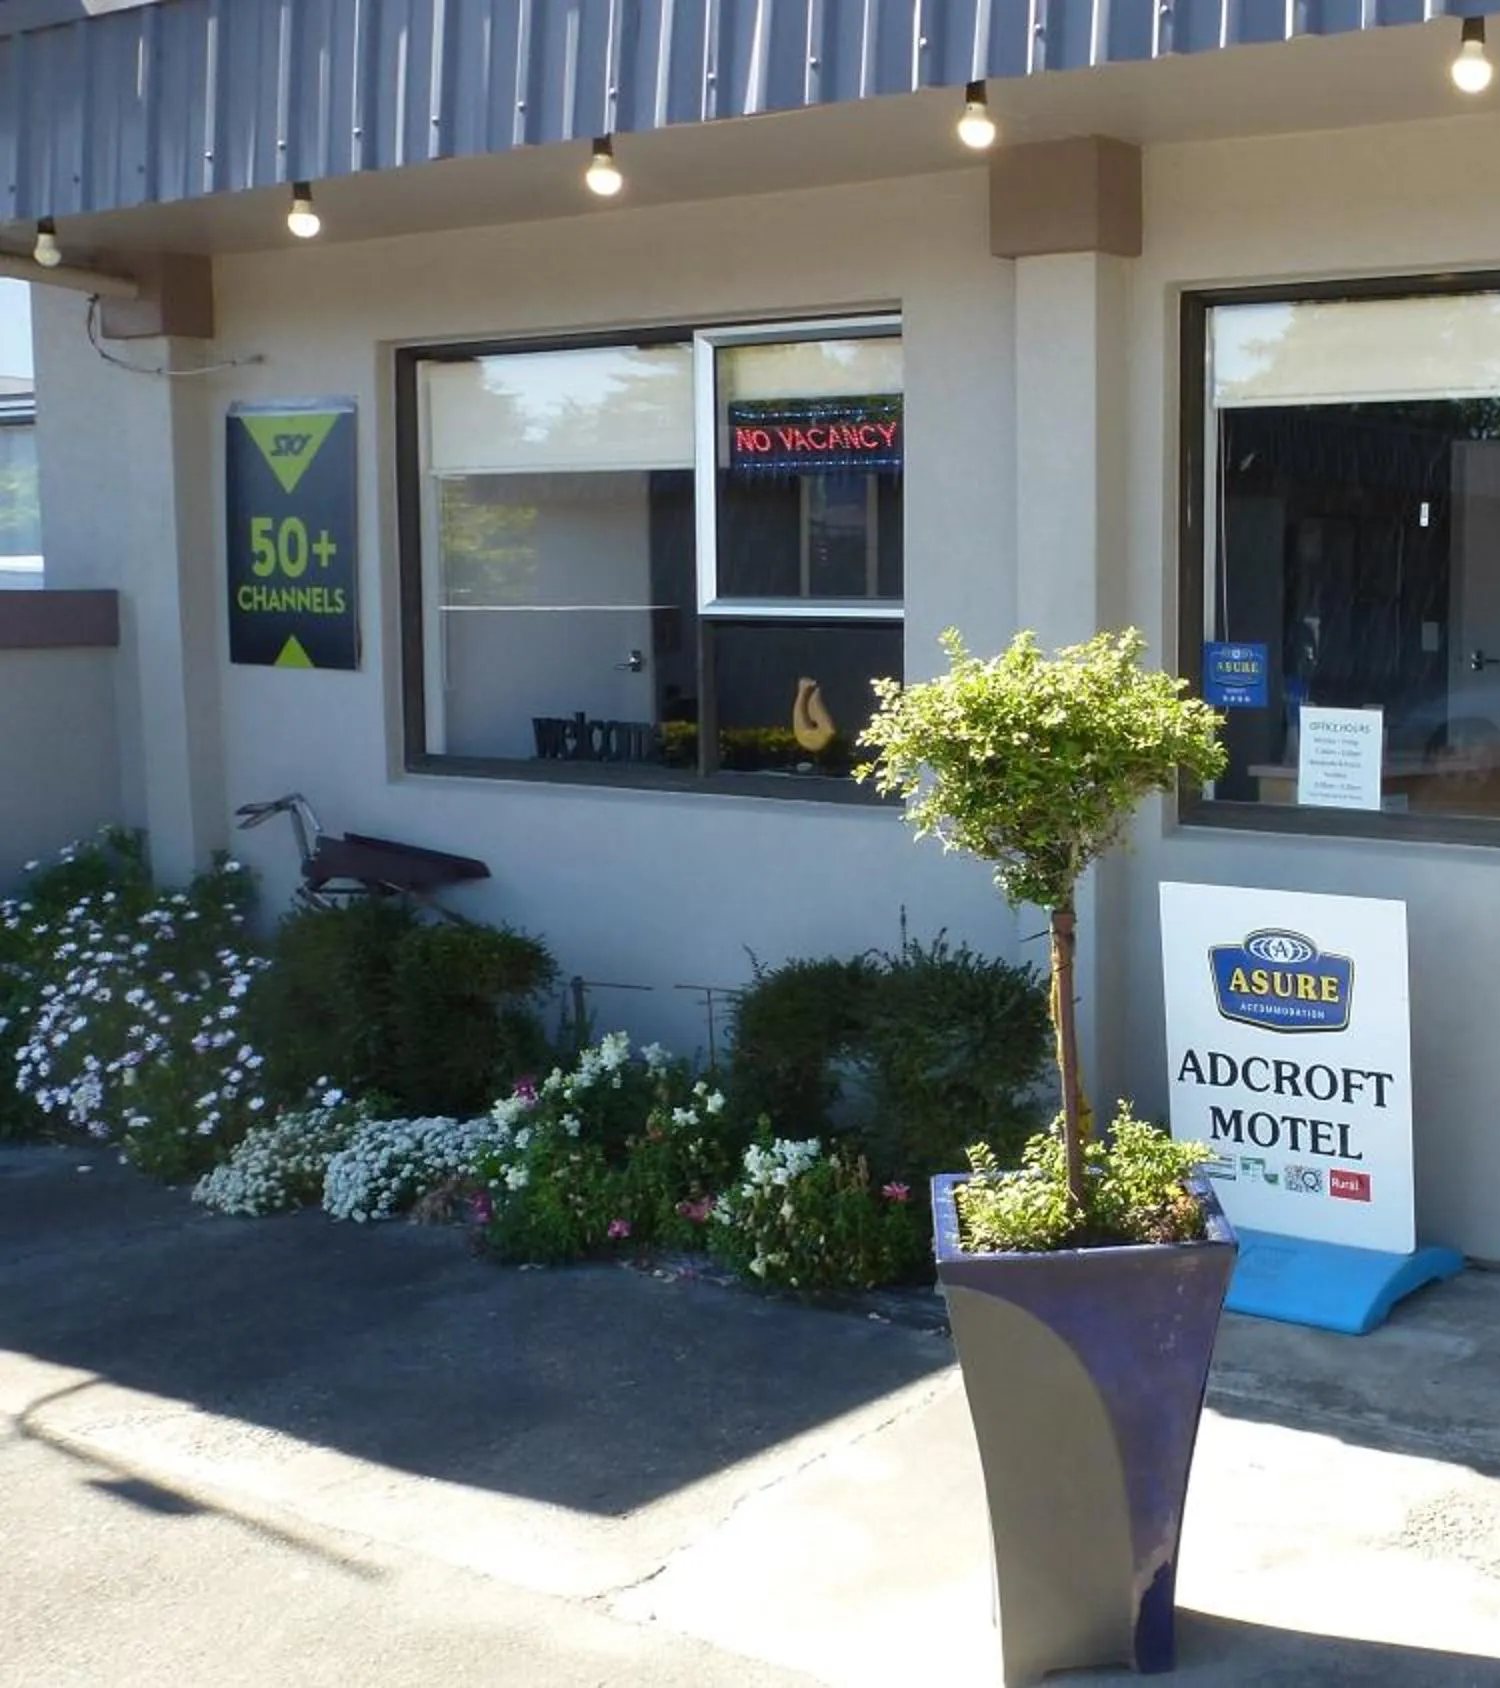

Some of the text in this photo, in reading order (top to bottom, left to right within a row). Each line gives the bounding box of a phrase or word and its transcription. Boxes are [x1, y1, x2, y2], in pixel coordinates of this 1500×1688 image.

[271, 433, 313, 457] SKY
[736, 421, 898, 452] NO VACANCY
[251, 516, 337, 578] 50+
[237, 585, 347, 614] CHANNELS
[1216, 661, 1260, 673] ASURE
[1229, 967, 1340, 1003] ASURE
[1177, 1048, 1394, 1108] ADCROFT
[1209, 1106, 1363, 1160] MOTEL
[1331, 1176, 1360, 1192] Rural
